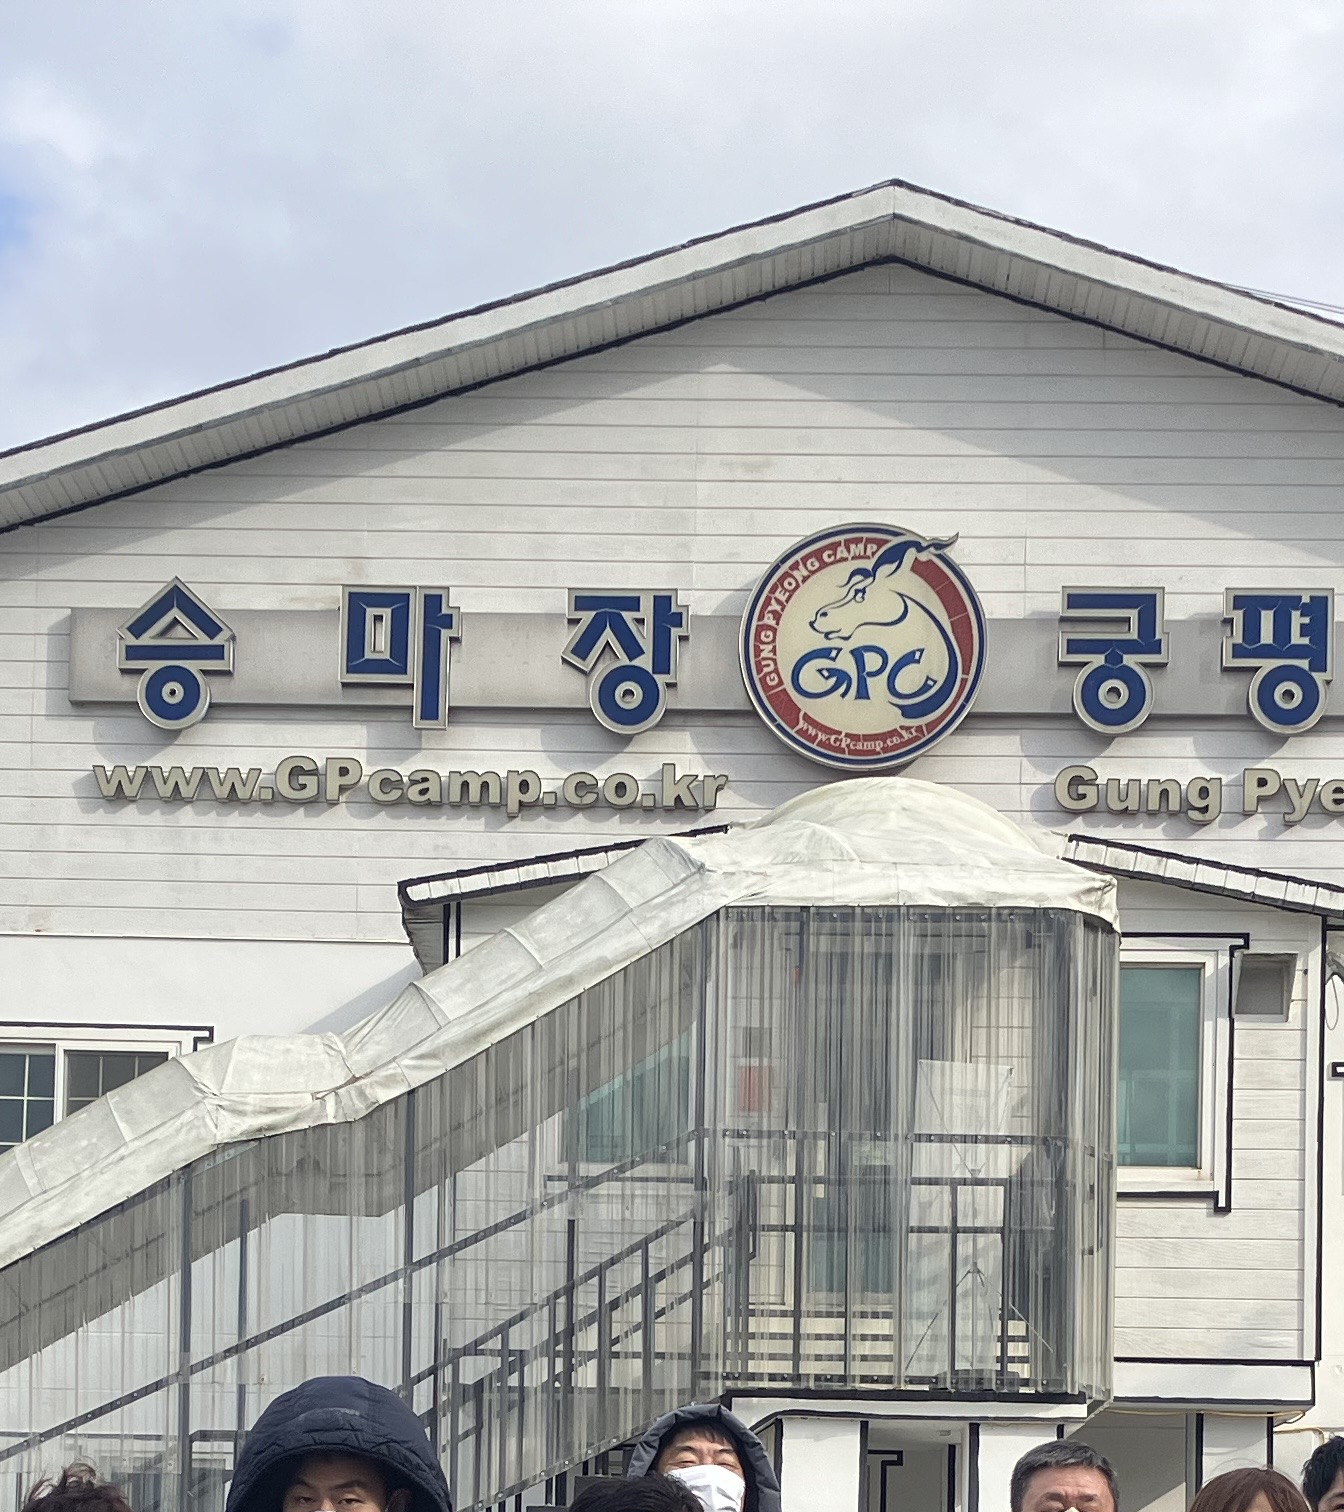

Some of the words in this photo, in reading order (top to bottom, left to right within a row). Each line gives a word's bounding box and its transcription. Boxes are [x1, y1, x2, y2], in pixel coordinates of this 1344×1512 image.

[822, 542, 879, 562] CAMP
[763, 554, 820, 627] PYEONG
[114, 575, 690, 735] 승마장
[758, 629, 780, 686] GUNG
[791, 645, 937, 700] GPC
[92, 756, 730, 818] www.GPcamp.co.kr
[1054, 765, 1223, 824] Gung
